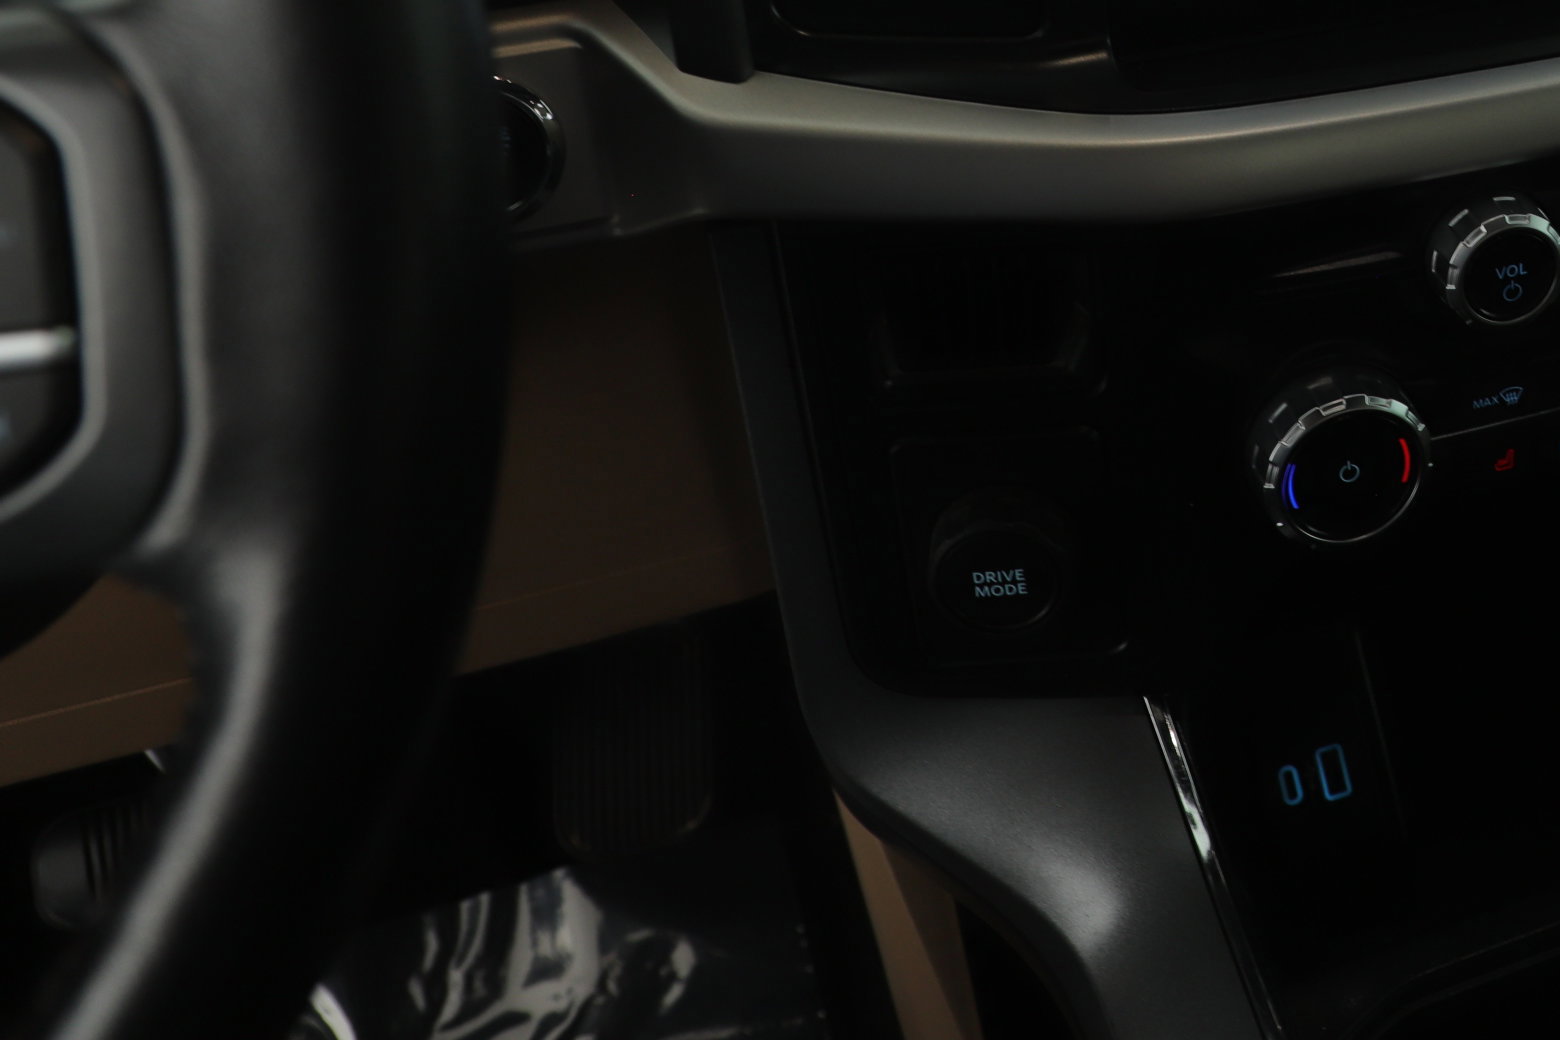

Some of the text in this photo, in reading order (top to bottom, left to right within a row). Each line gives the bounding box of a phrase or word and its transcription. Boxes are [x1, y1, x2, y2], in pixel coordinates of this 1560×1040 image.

[1495, 262, 1528, 280] VOL
[1472, 394, 1500, 409] MAX
[971, 568, 1026, 584] DRIVE
[974, 582, 1029, 598] MODE
